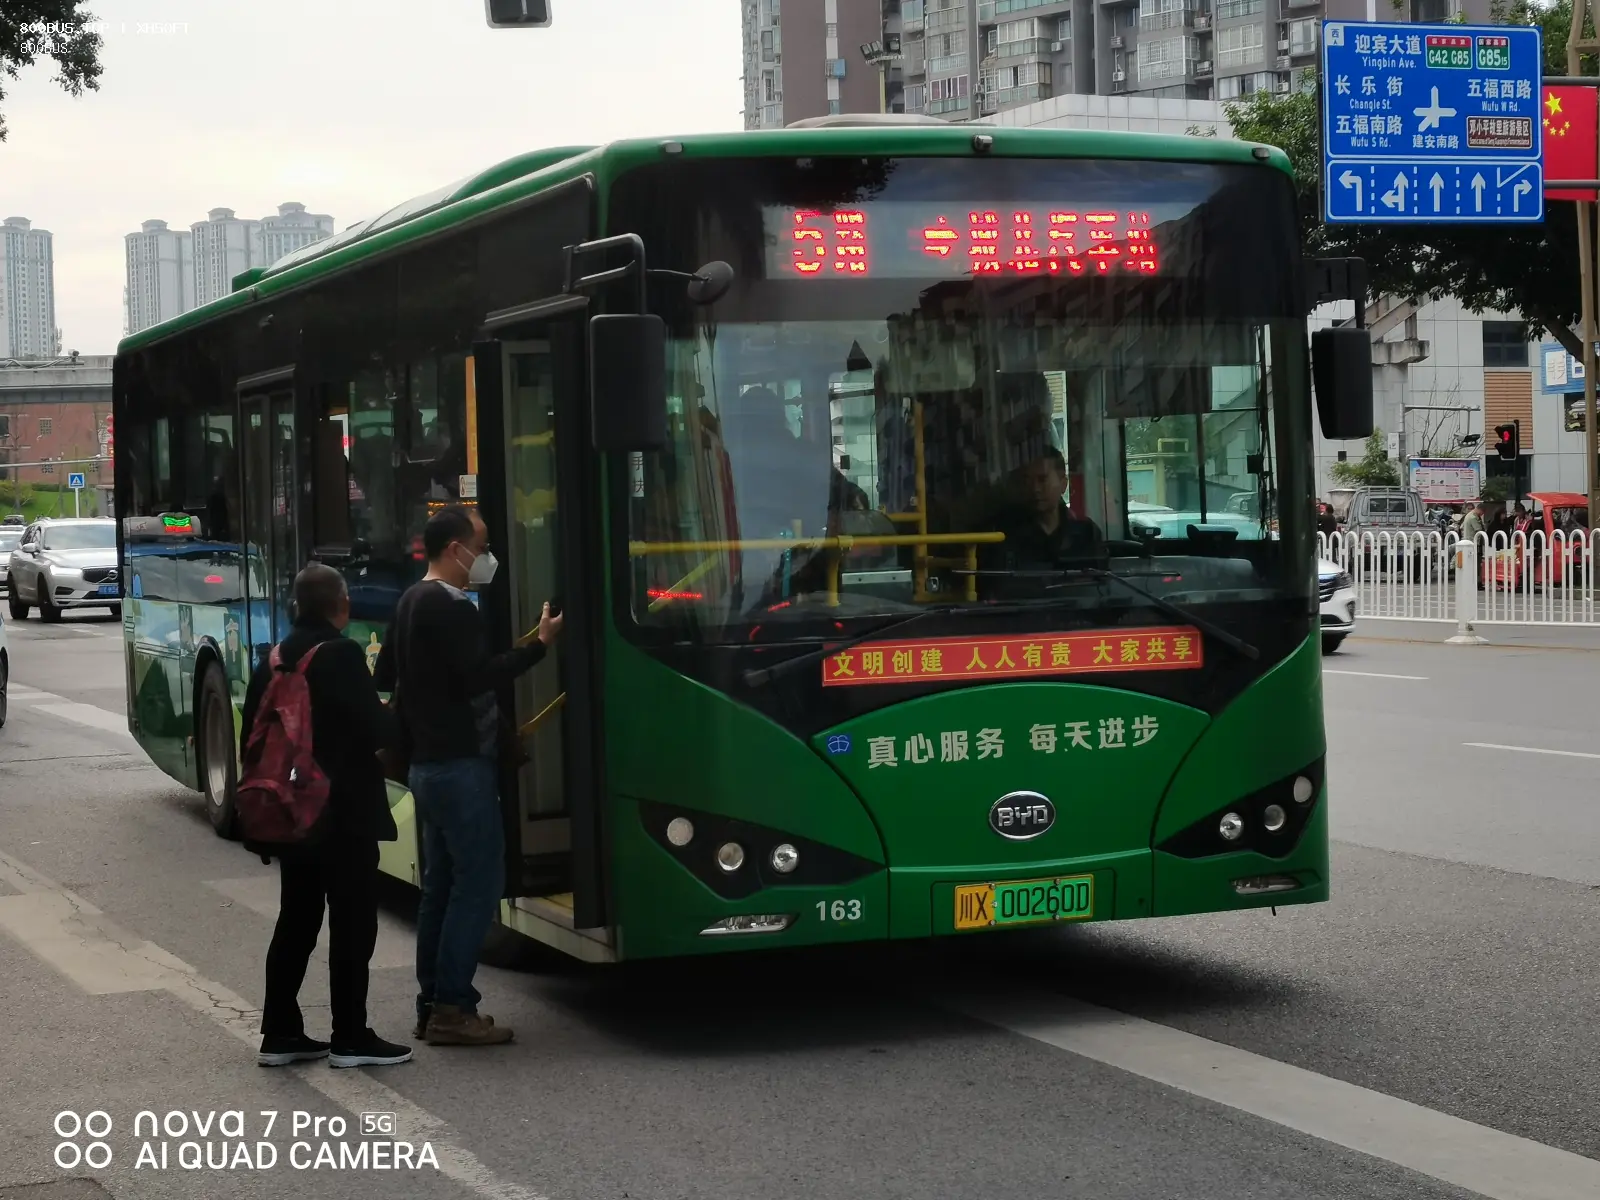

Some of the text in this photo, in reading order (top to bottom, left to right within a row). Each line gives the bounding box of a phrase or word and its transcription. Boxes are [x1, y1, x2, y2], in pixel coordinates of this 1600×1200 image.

[1355, 34, 1422, 56] 迎宾大道
[1362, 57, 1417, 70] Yingbin Ave.
[1428, 49, 1470, 65] G42 G85
[1334, 75, 1403, 97] 长乐街
[1467, 79, 1532, 99] 五福西路
[1349, 98, 1392, 111] Changle St.
[1481, 101, 1521, 112] Wufu W Rd.
[1336, 115, 1403, 136] 五福南路
[1350, 136, 1392, 148] Wufu S Rd.
[1412, 134, 1459, 150] 建安南路
[833, 635, 1194, 677] 文明创建 人人有责 大家共享
[866, 715, 1160, 770] 真心服务 每天进步
[997, 804, 1049, 827] BYD
[815, 898, 862, 921] 163
